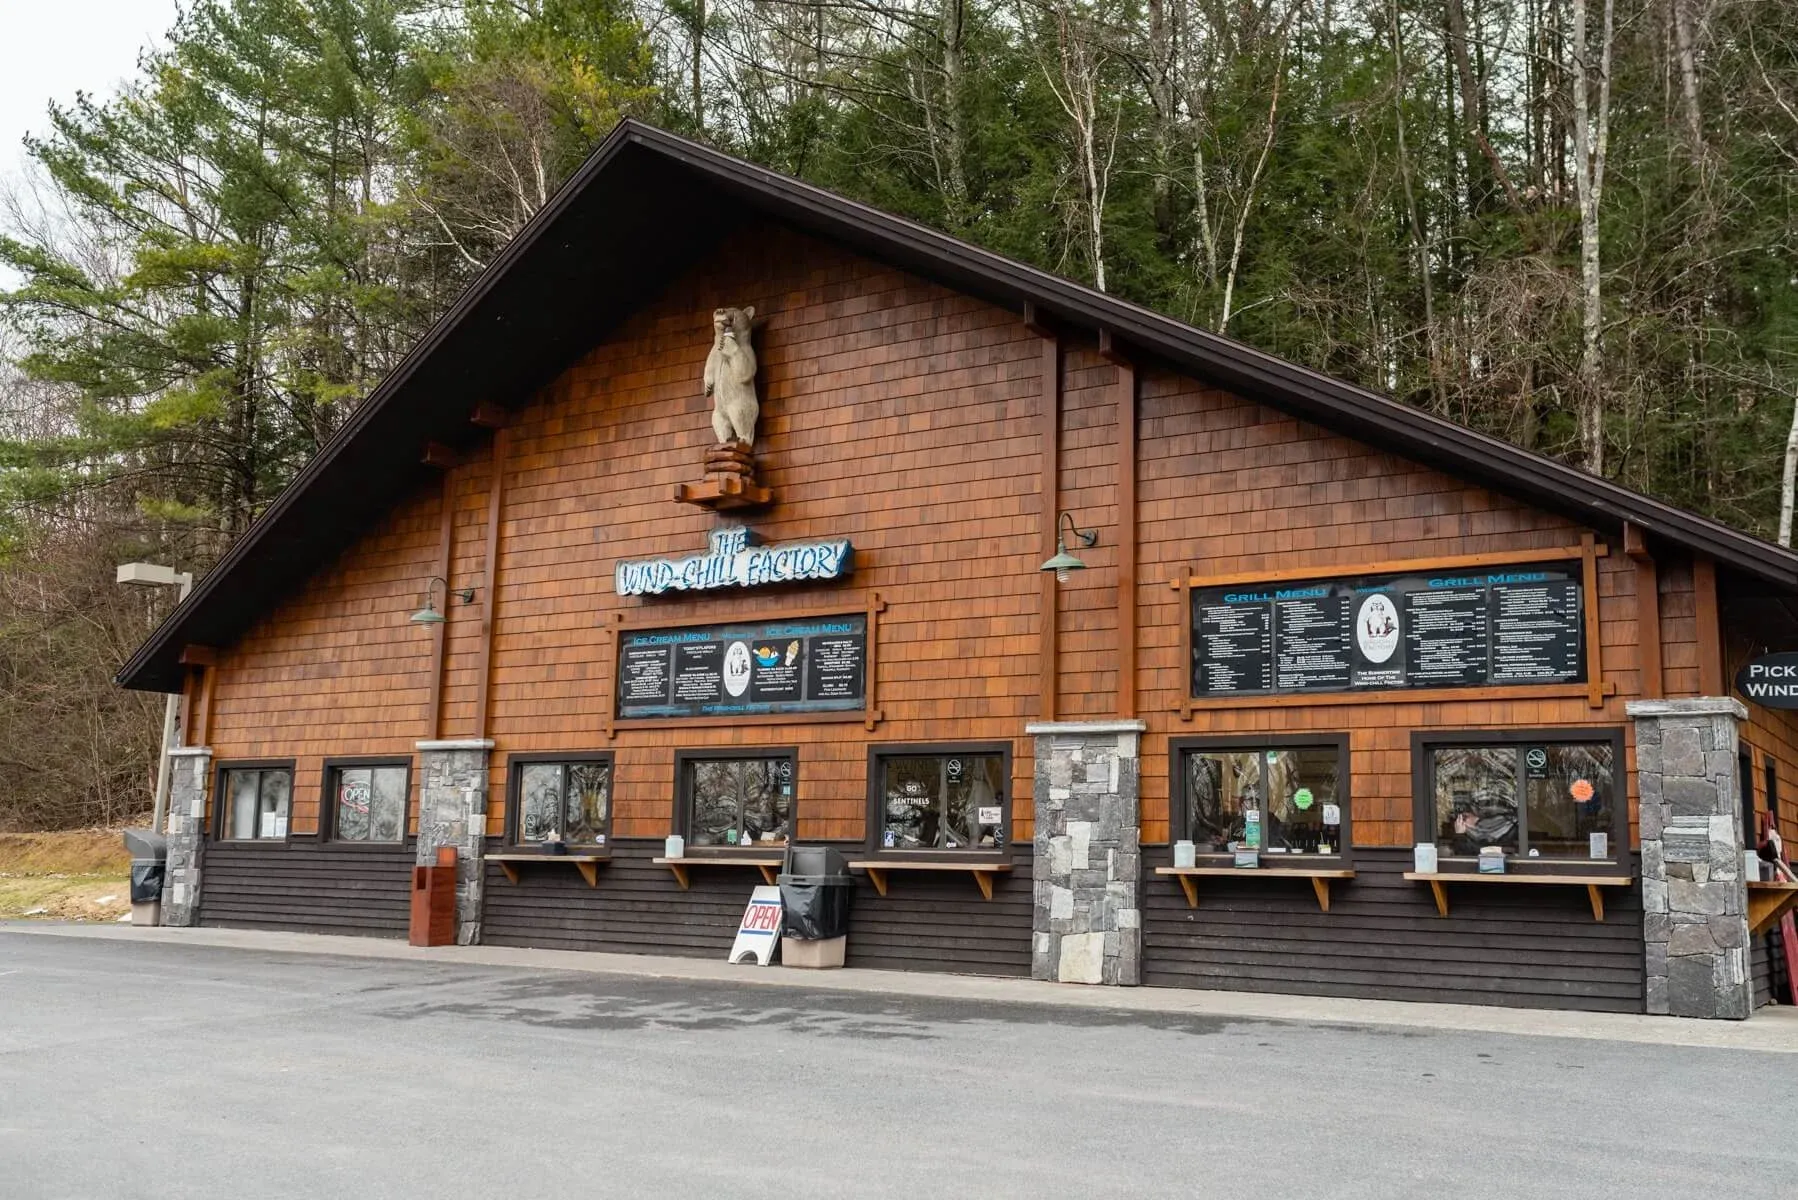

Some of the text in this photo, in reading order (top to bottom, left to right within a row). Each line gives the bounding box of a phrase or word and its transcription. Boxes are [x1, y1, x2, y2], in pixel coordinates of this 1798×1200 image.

[715, 530, 747, 554] THE
[622, 542, 848, 593] WIND-CHILL FACTORY
[1224, 588, 1327, 603] GRILL MENU
[821, 623, 852, 633] MENU
[1750, 664, 1797, 677] PICK
[344, 787, 370, 801] OPEN
[743, 904, 781, 930] OPEN
